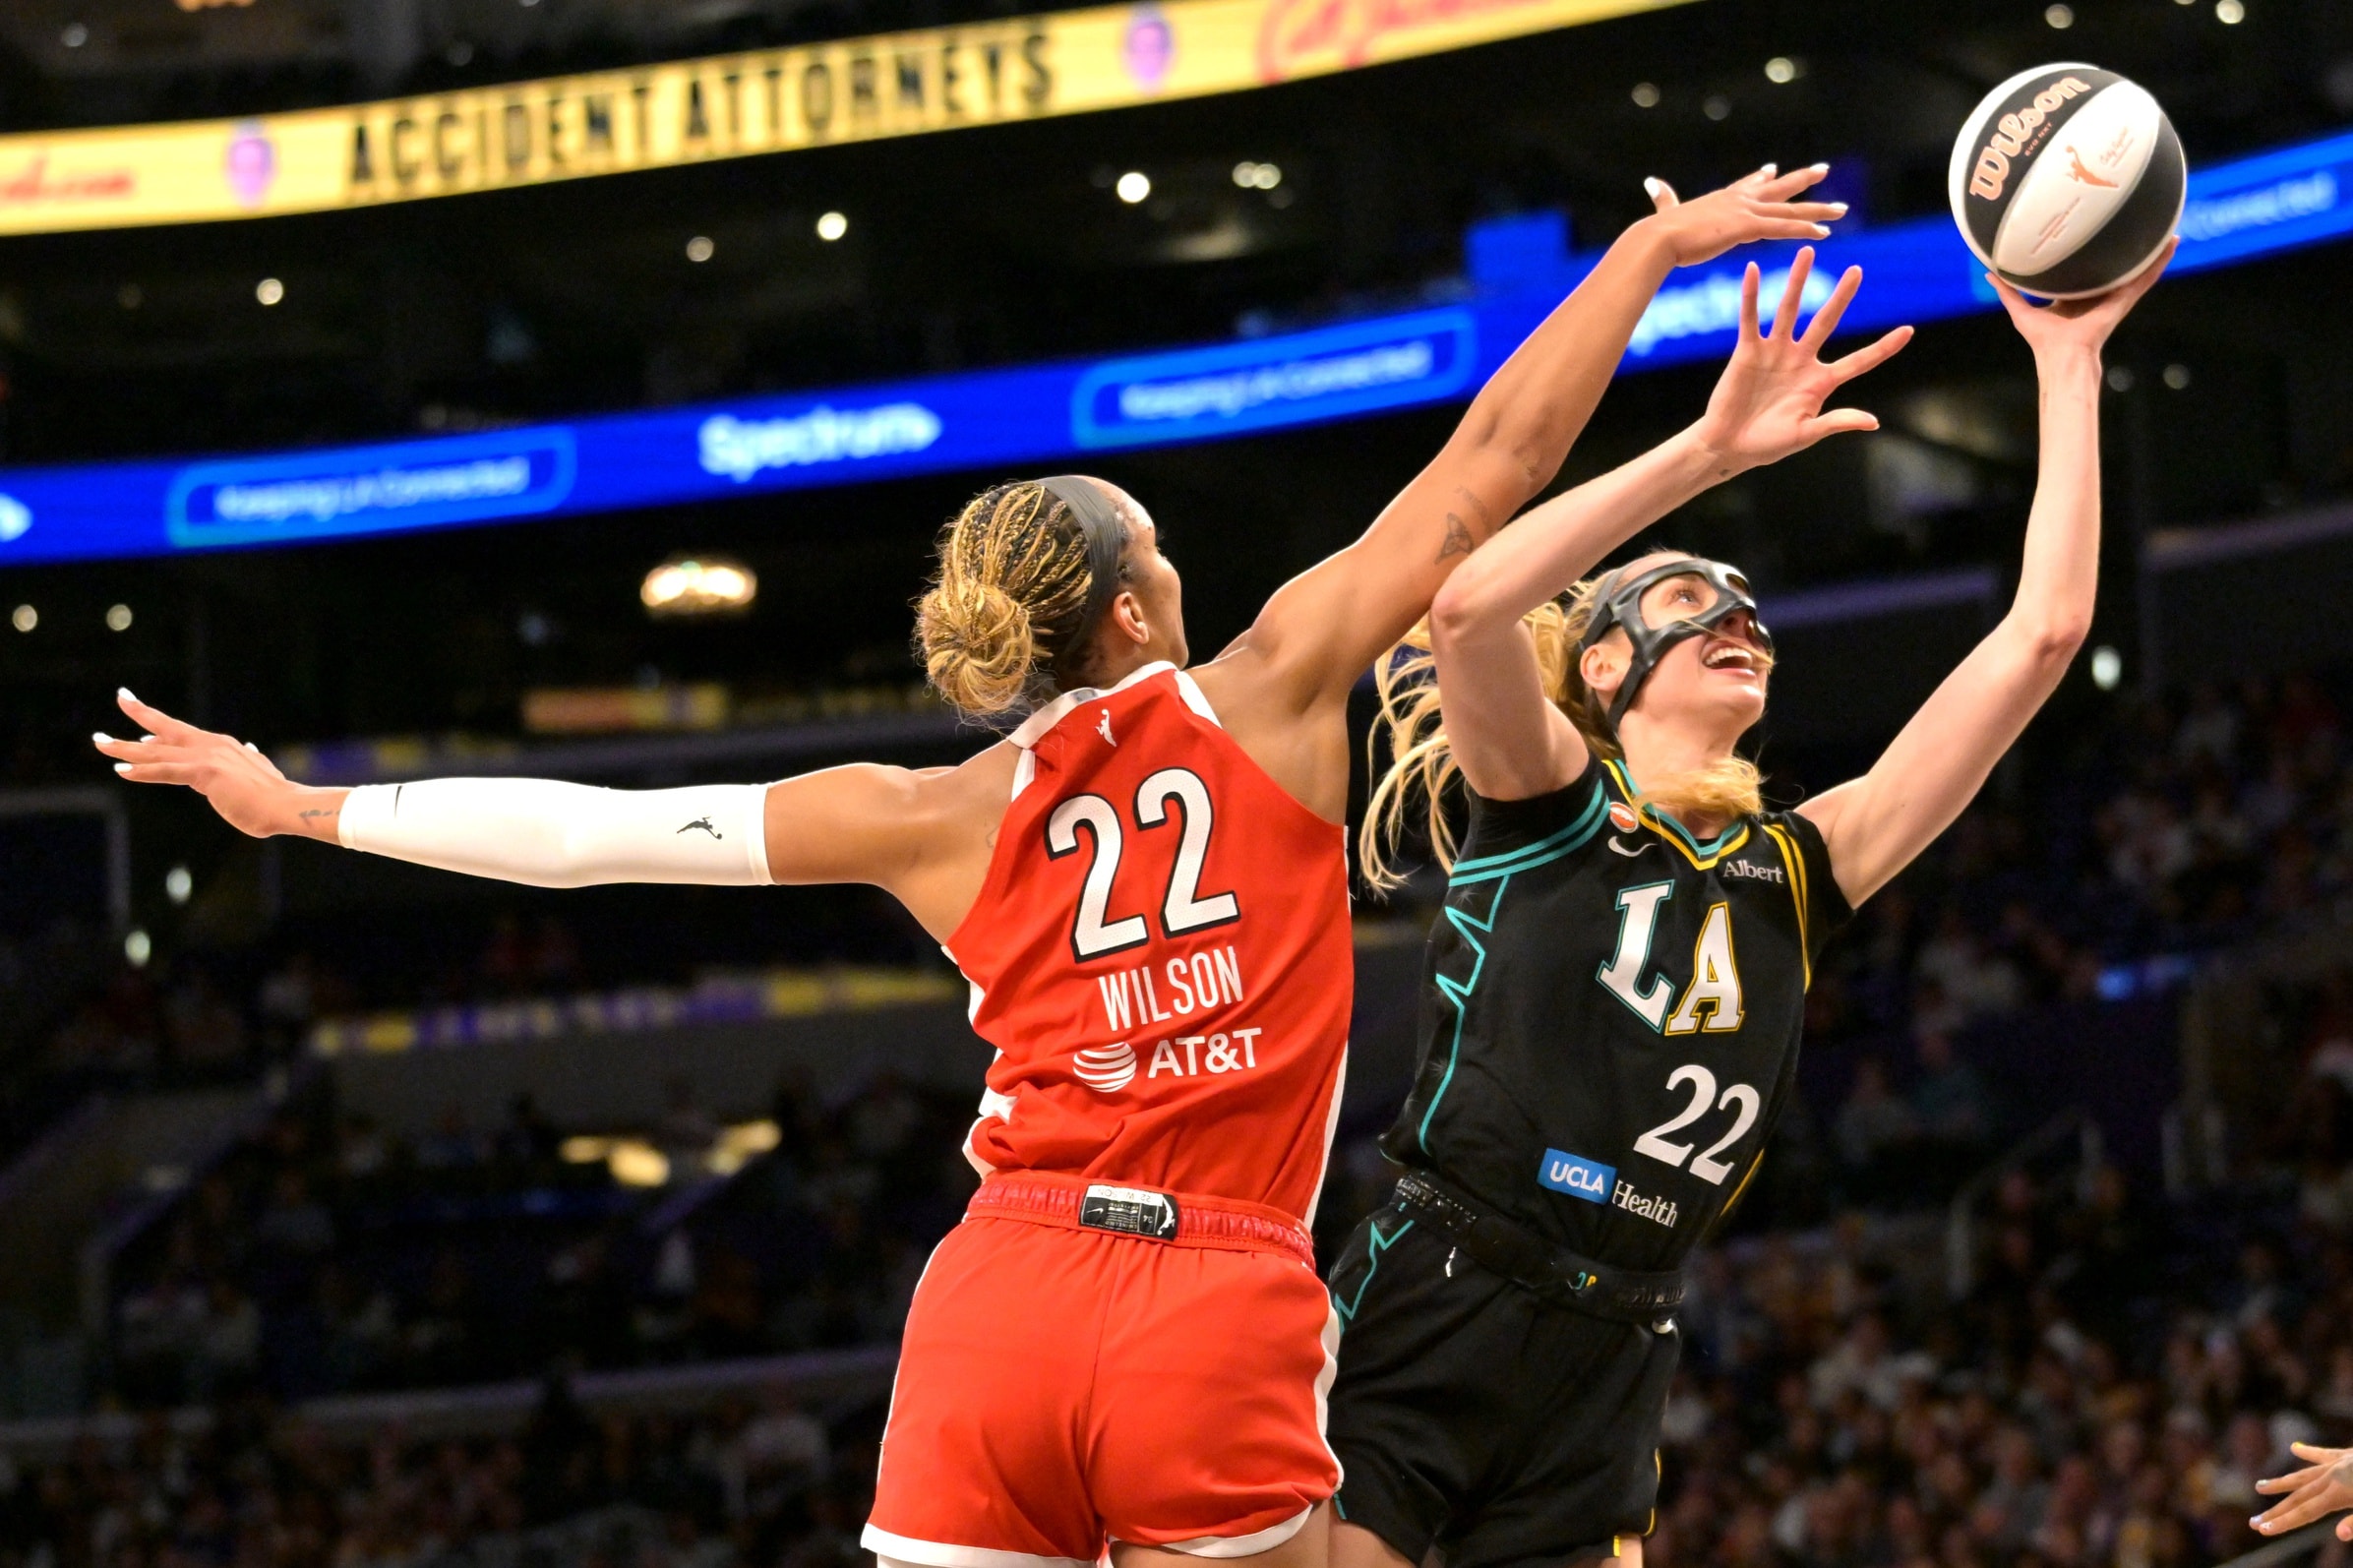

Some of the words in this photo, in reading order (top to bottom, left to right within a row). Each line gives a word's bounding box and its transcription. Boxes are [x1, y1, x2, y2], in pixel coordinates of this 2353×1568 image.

[347, 81, 655, 184] ACCIDENT
[681, 31, 1055, 138] ATTORNEYS
[1968, 76, 2091, 201] Wilson
[1045, 765, 1241, 963] 22
[1723, 859, 1783, 883] Albert
[1098, 945, 1243, 1031] WILSON
[1596, 878, 1745, 1036] LA
[1148, 1027, 1262, 1079] AT&T
[1633, 1064, 1760, 1186] 22
[1549, 1160, 1603, 1195] UCLA
[1612, 1179, 1678, 1228] Health
